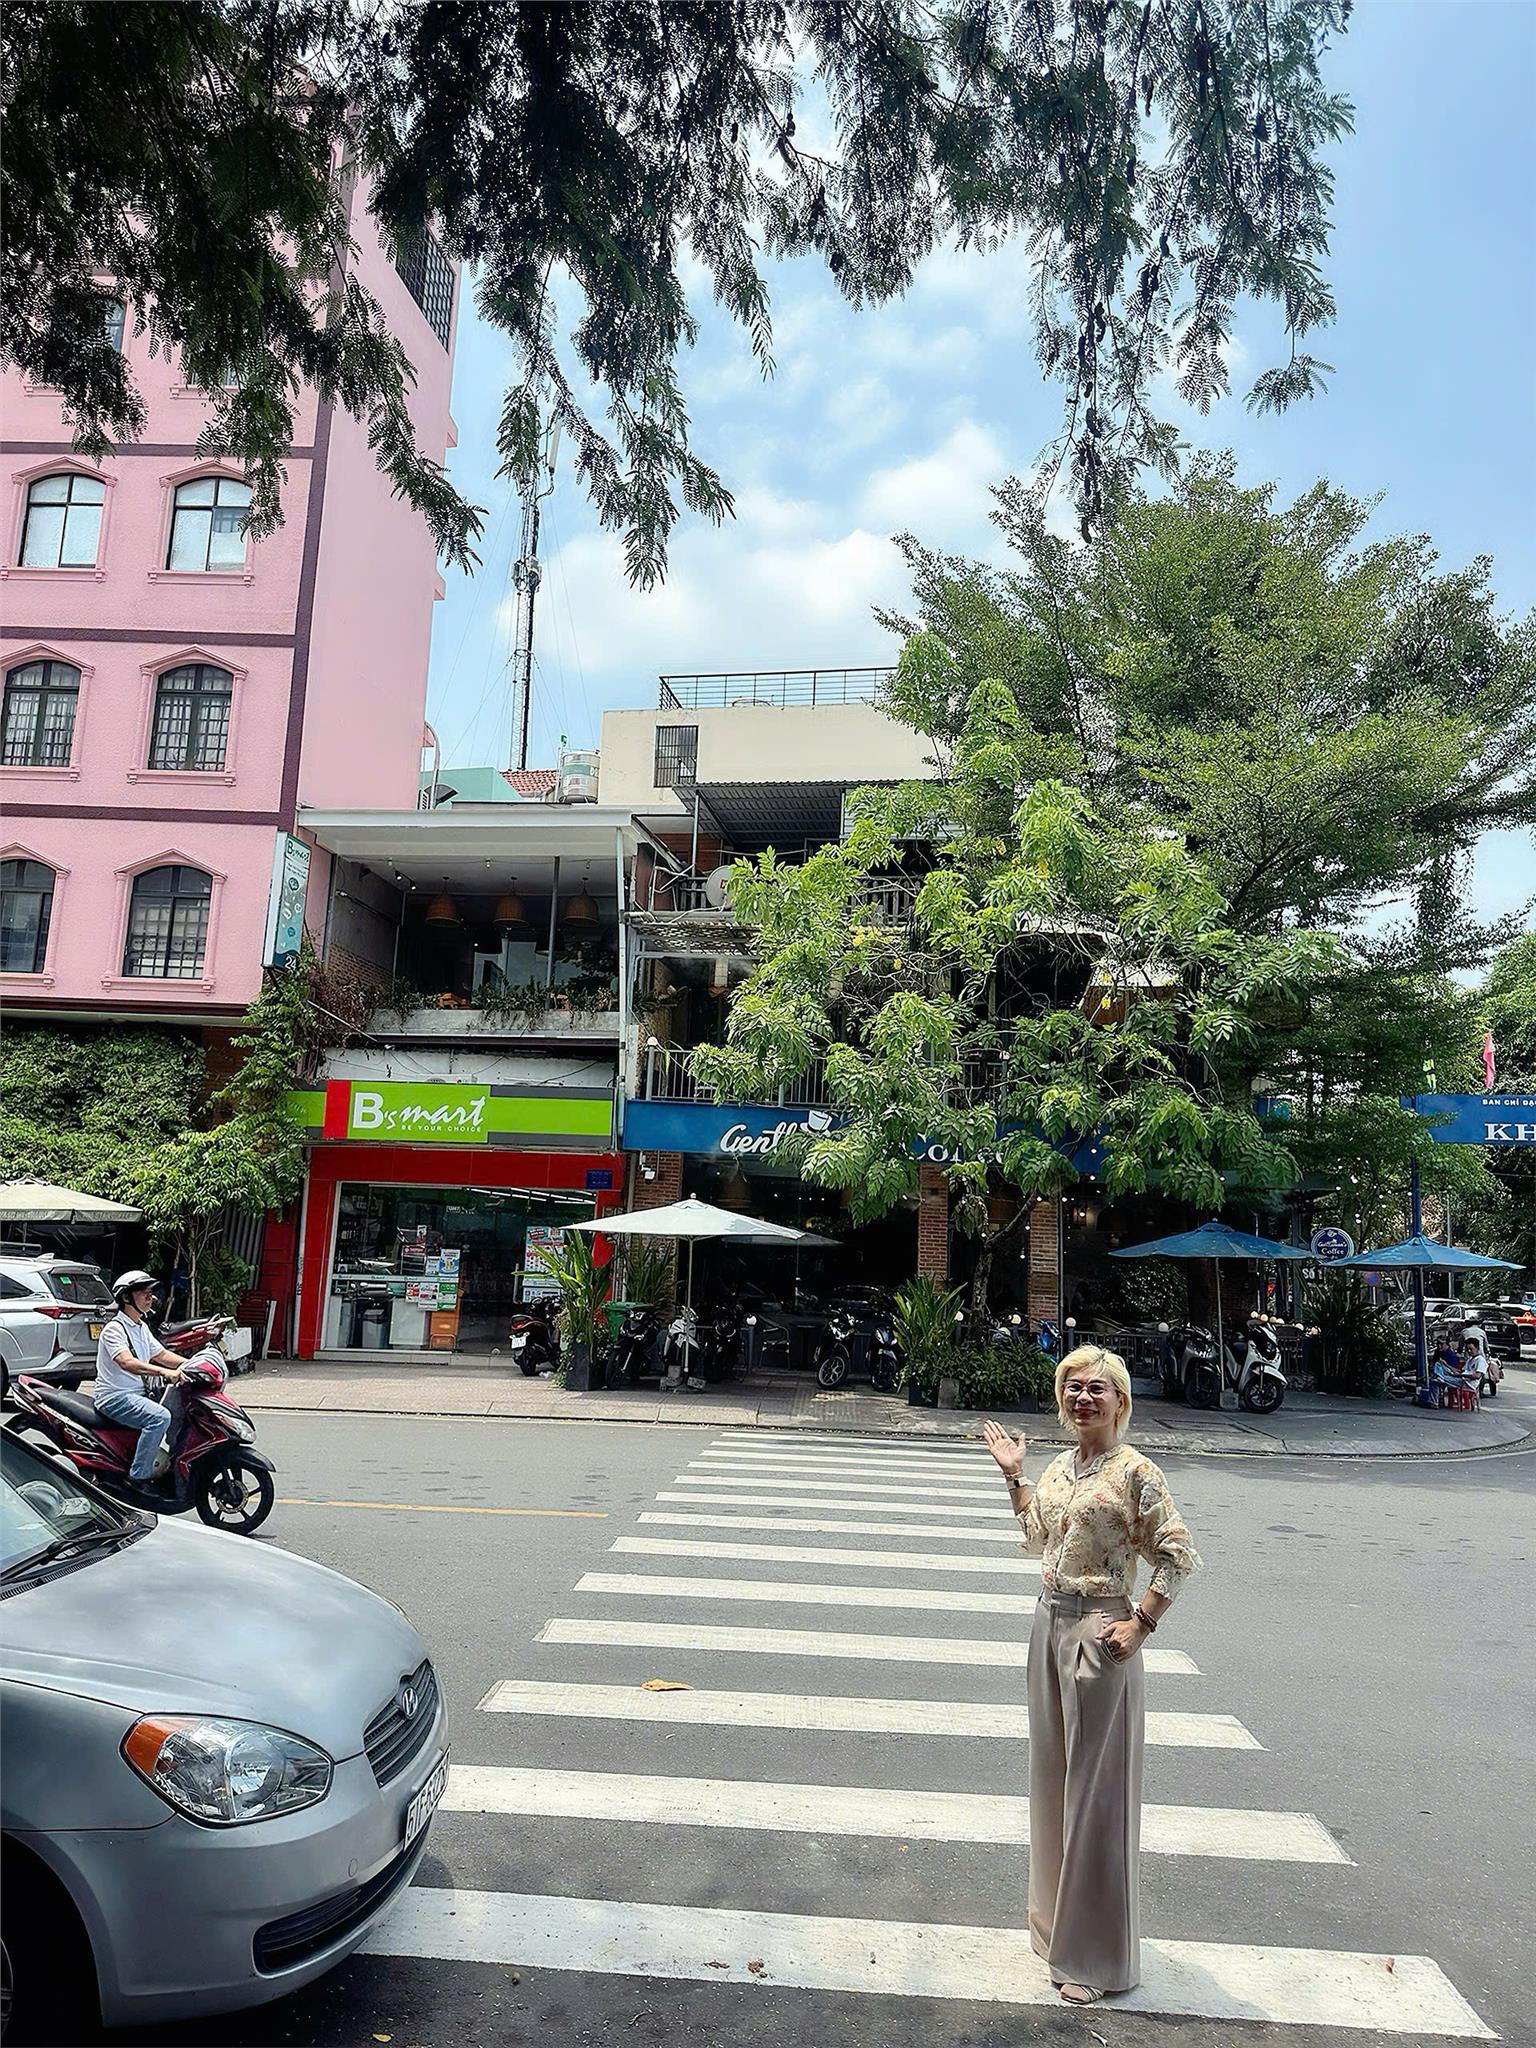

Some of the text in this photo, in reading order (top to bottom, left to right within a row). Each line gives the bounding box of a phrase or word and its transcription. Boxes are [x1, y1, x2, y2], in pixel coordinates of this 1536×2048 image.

[1522, 1099, 1536, 1108] ĐẠ
[447, 1125, 481, 1133] CHOICE
[1322, 1247, 1344, 1255] Coffee
